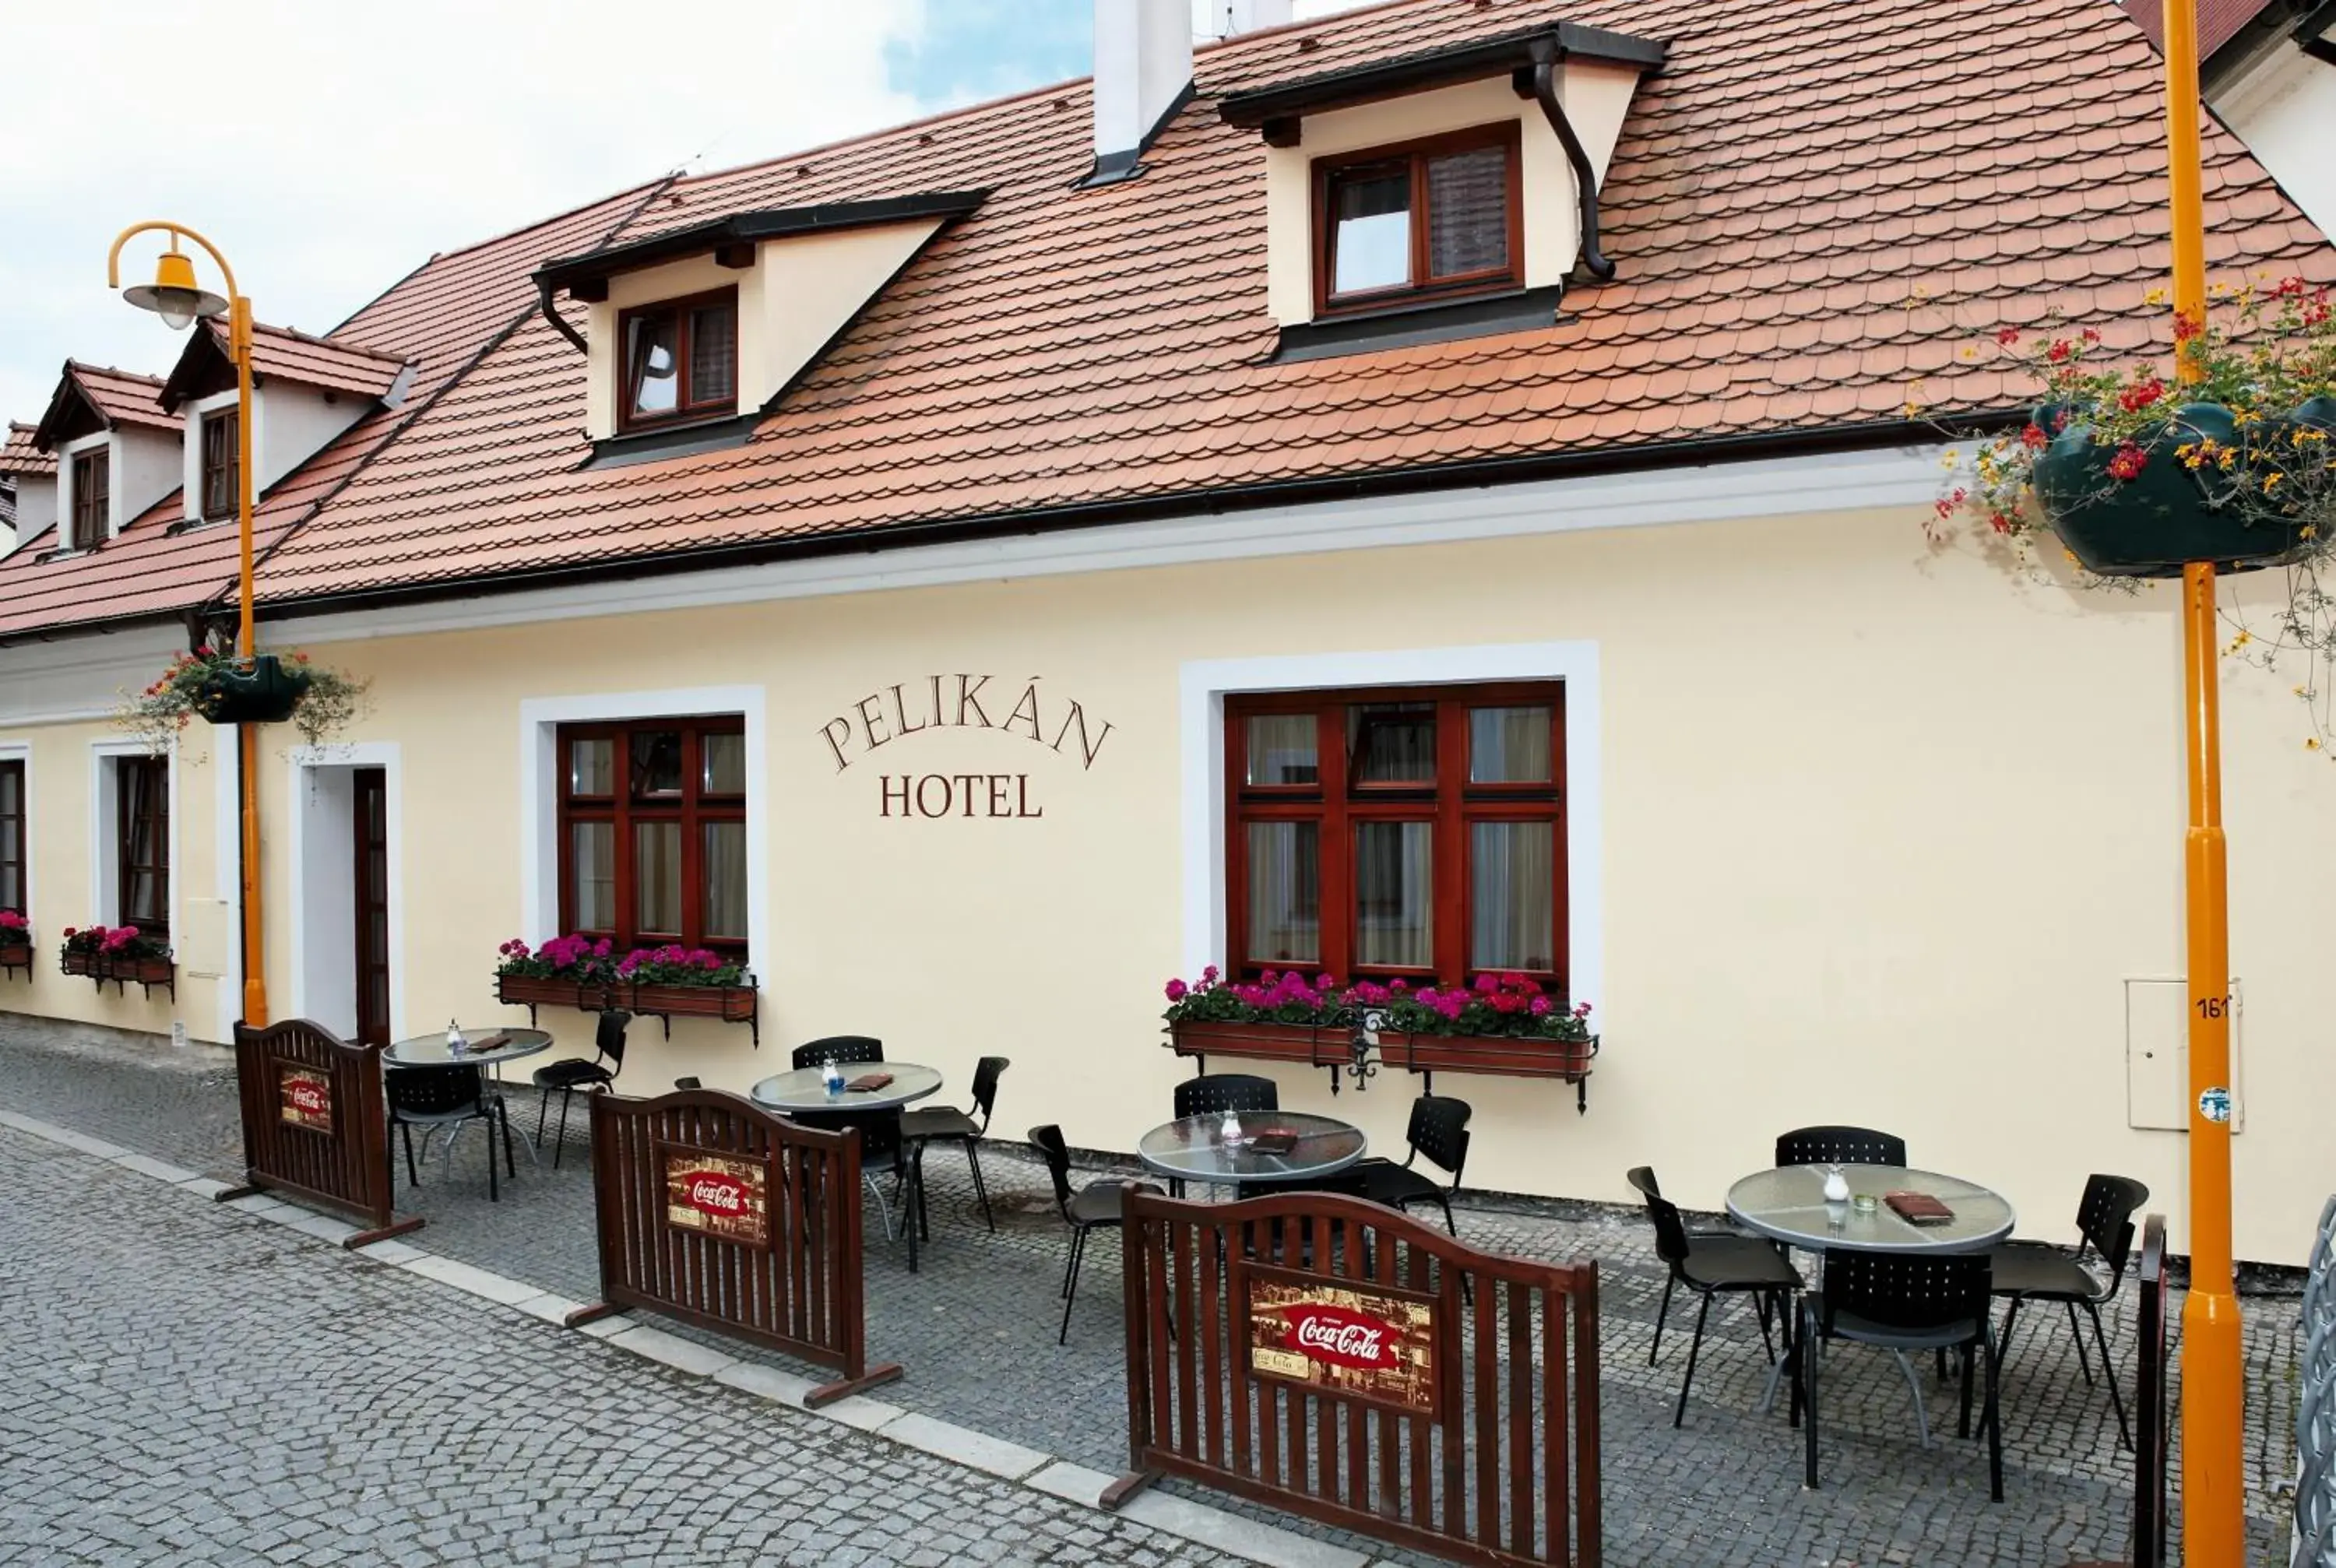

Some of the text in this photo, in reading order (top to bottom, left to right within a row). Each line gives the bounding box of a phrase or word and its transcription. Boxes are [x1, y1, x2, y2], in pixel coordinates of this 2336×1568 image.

[817, 673, 1117, 775] PELIKÁN
[879, 774, 1043, 818] HOTEL
[2197, 997, 2229, 1019] 161
[693, 1180, 740, 1210] Coca-Cola
[1298, 1316, 1382, 1360] Coca-Cola
